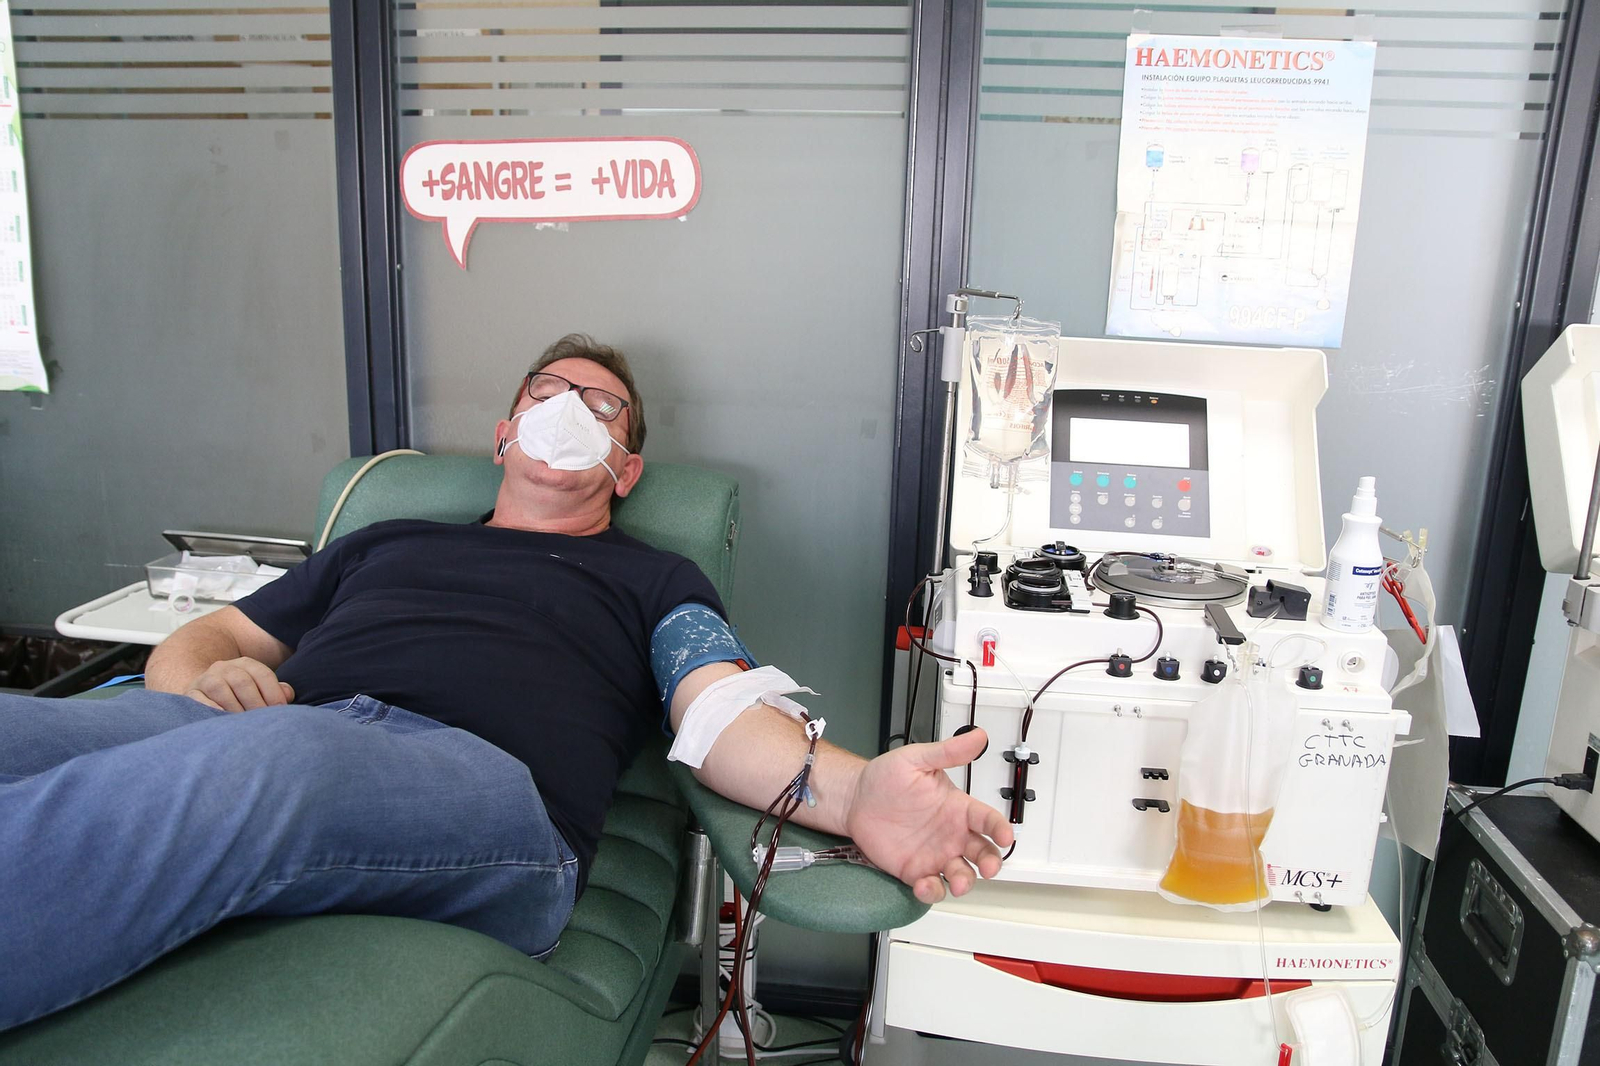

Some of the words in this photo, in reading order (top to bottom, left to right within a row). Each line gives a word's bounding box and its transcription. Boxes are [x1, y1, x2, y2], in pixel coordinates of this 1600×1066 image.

[1141, 73, 1185, 82] INSTALACIÓN
[1213, 76, 1249, 84] PLAQUETAS
[1250, 77, 1312, 85] LEUCORREDUCIDAS
[1313, 78, 1330, 86] 9941
[422, 161, 546, 201] +SANGRE
[591, 158, 677, 199] +VIDA
[1304, 734, 1366, 750] CTTC
[1299, 753, 1387, 769] GRANADA
